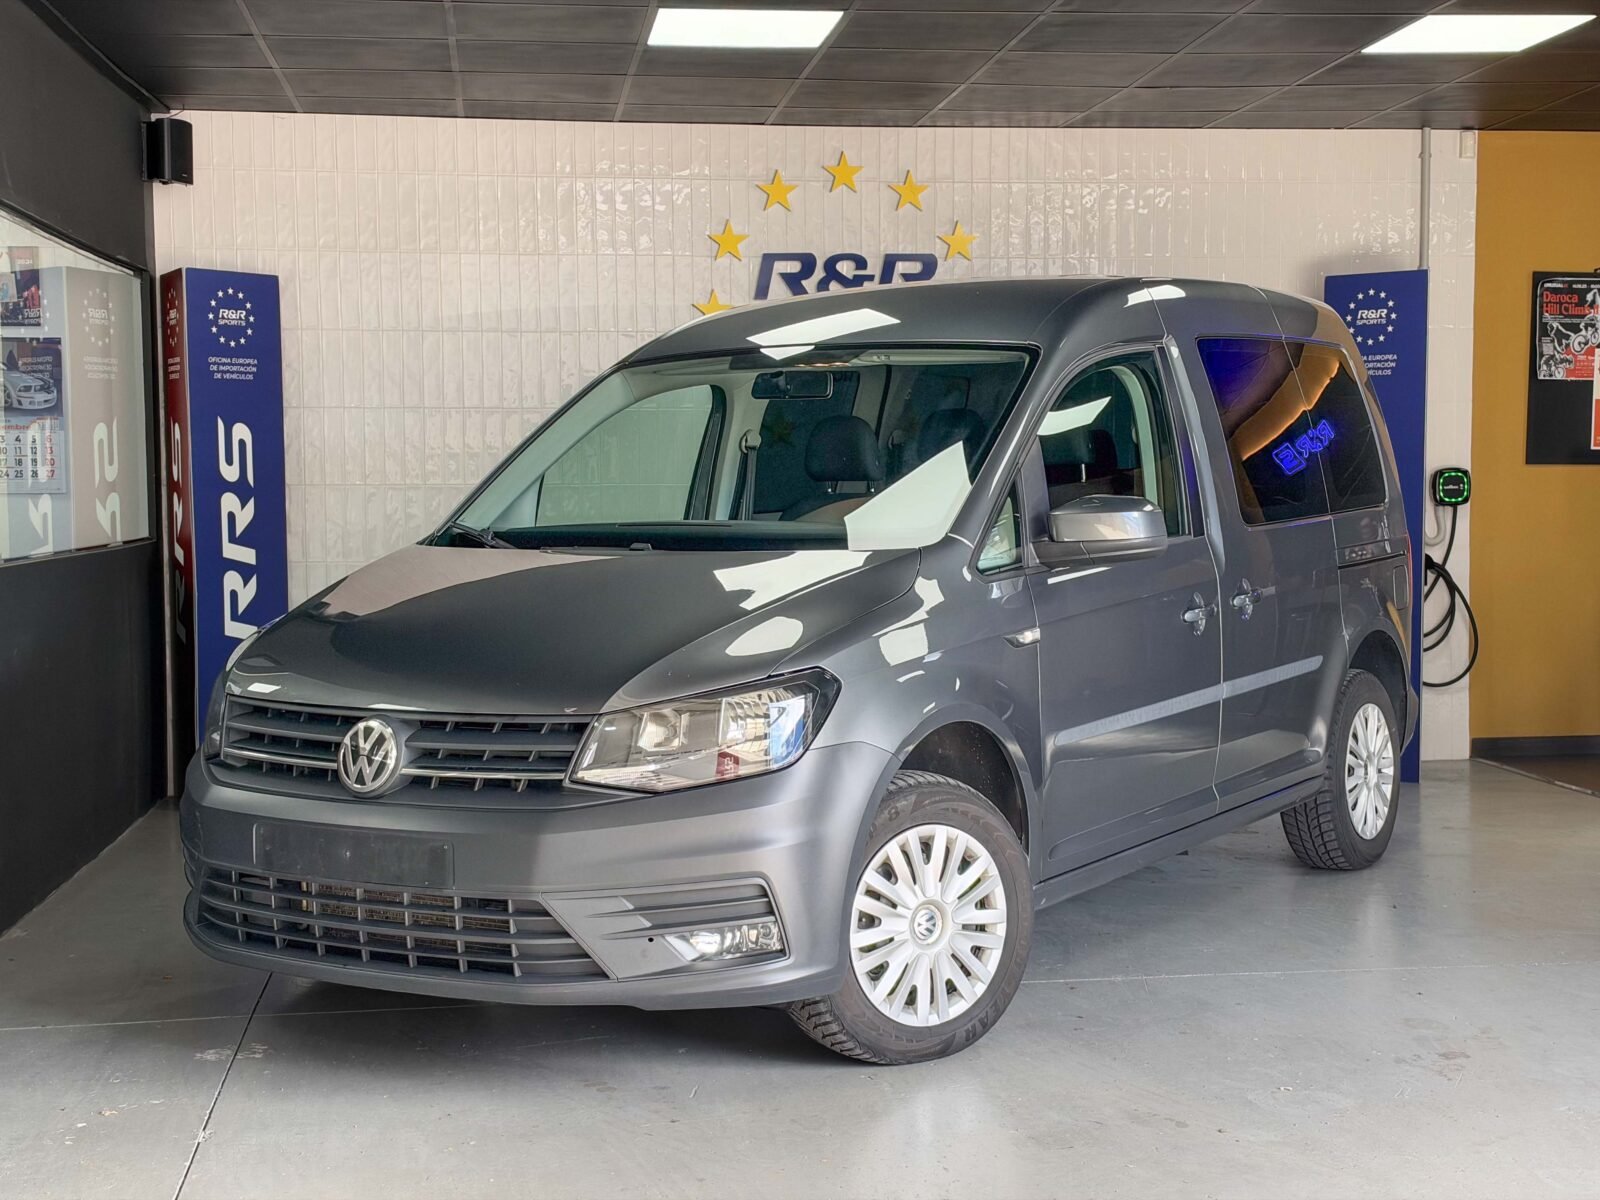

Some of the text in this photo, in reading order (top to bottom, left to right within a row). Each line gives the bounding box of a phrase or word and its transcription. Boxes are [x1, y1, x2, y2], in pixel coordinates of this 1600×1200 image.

[1543, 291, 1579, 303] Daroca
[1357, 308, 1388, 319] R&R
[1543, 303, 1560, 315] Hill
[218, 309, 246, 320] R&R
[1356, 318, 1387, 326] SPORTS
[219, 364, 257, 372] IMPORTACIÓN
[1365, 361, 1396, 369] ORTACIÓN
[223, 372, 254, 380] VEHÍCULOS
[15, 435, 21, 443] 4
[31, 435, 37, 443] 5
[14, 446, 22, 455] 11
[30, 446, 38, 455] 12
[14, 458, 23, 467] 18
[30, 458, 38, 467] 19
[14, 470, 24, 478] 25
[31, 470, 39, 478] 26
[217, 415, 258, 639] RRS
